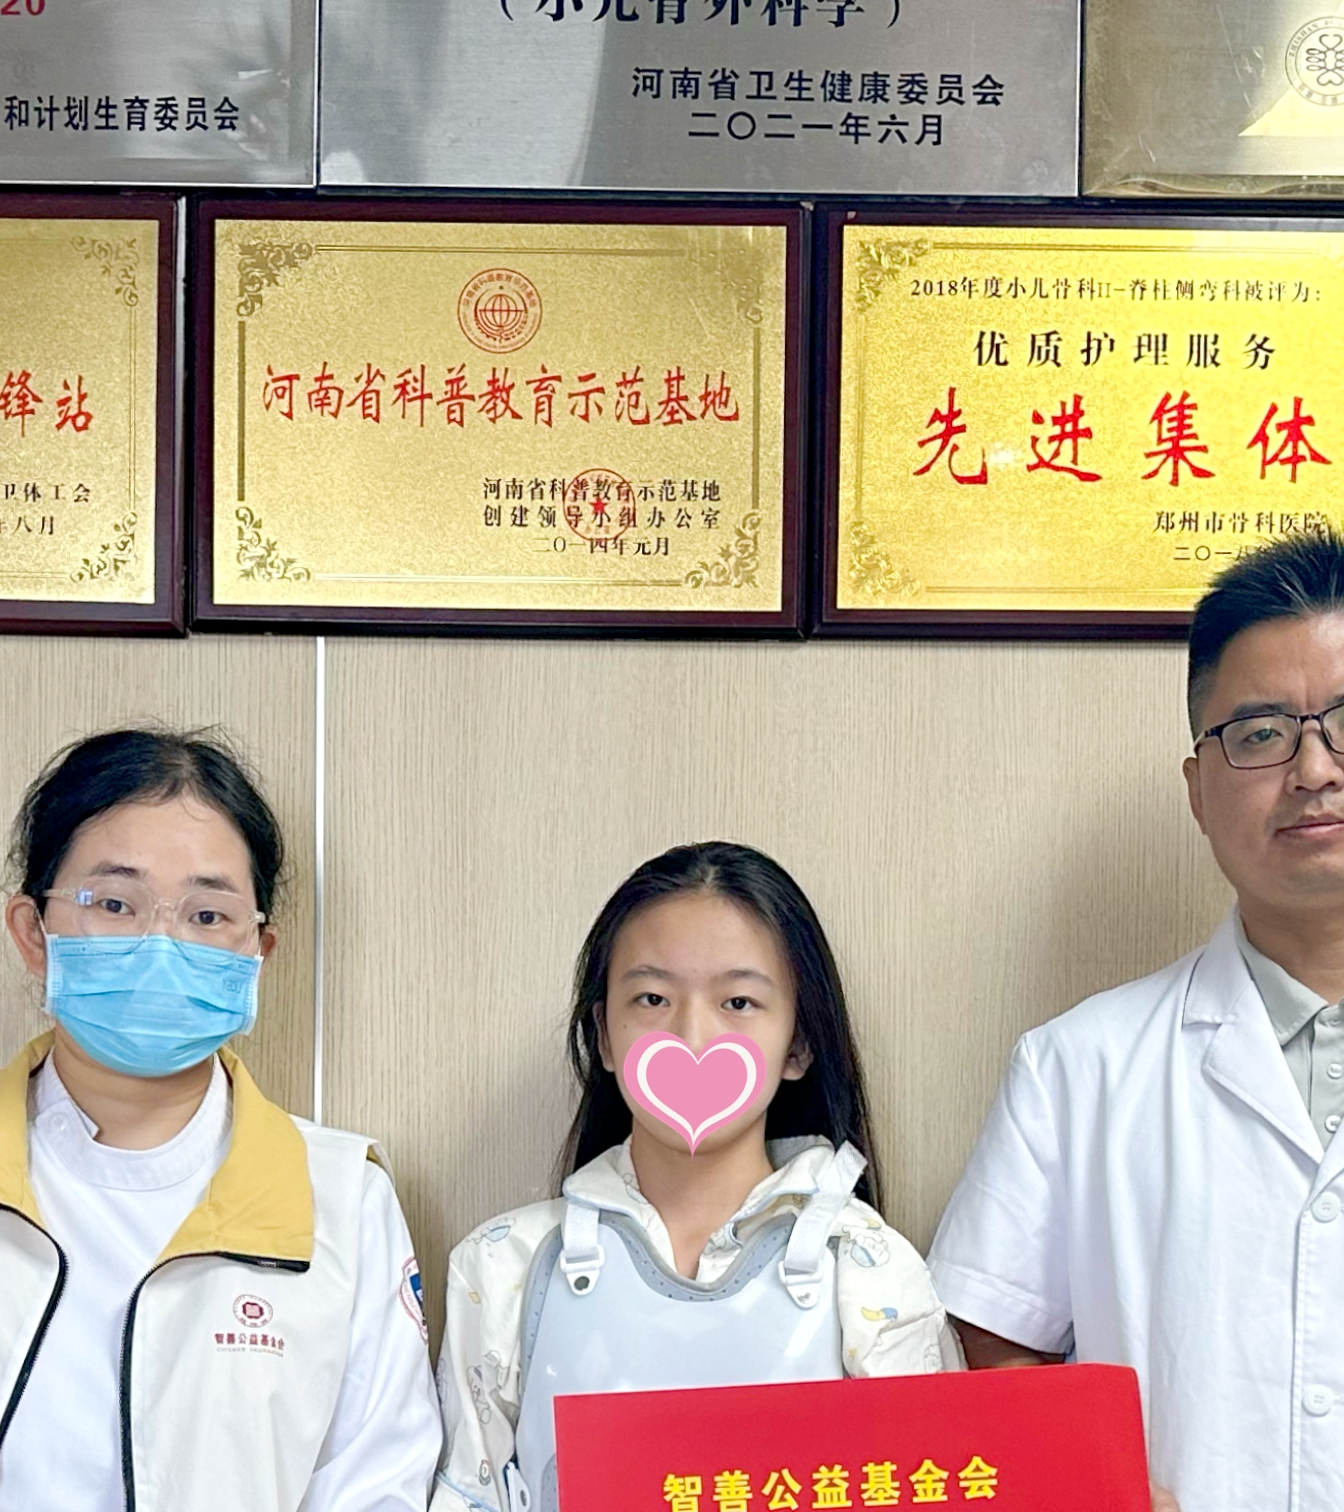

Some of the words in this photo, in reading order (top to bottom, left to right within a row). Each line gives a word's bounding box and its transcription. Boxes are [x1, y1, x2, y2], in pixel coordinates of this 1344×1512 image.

[631, 66, 1005, 106] 河南省卫生健康委员会
[688, 111, 945, 146] 二〇二一年六月
[973, 330, 1277, 370] 优质护理服务
[262, 361, 740, 429] 河南省科普教育示范基地
[913, 386, 1334, 487] 先进集体
[482, 477, 722, 502] 河南省科普教育示范基地
[482, 505, 721, 529] 创建领导小组办公室
[1153, 511, 1329, 534] 郑州市骨科医院
